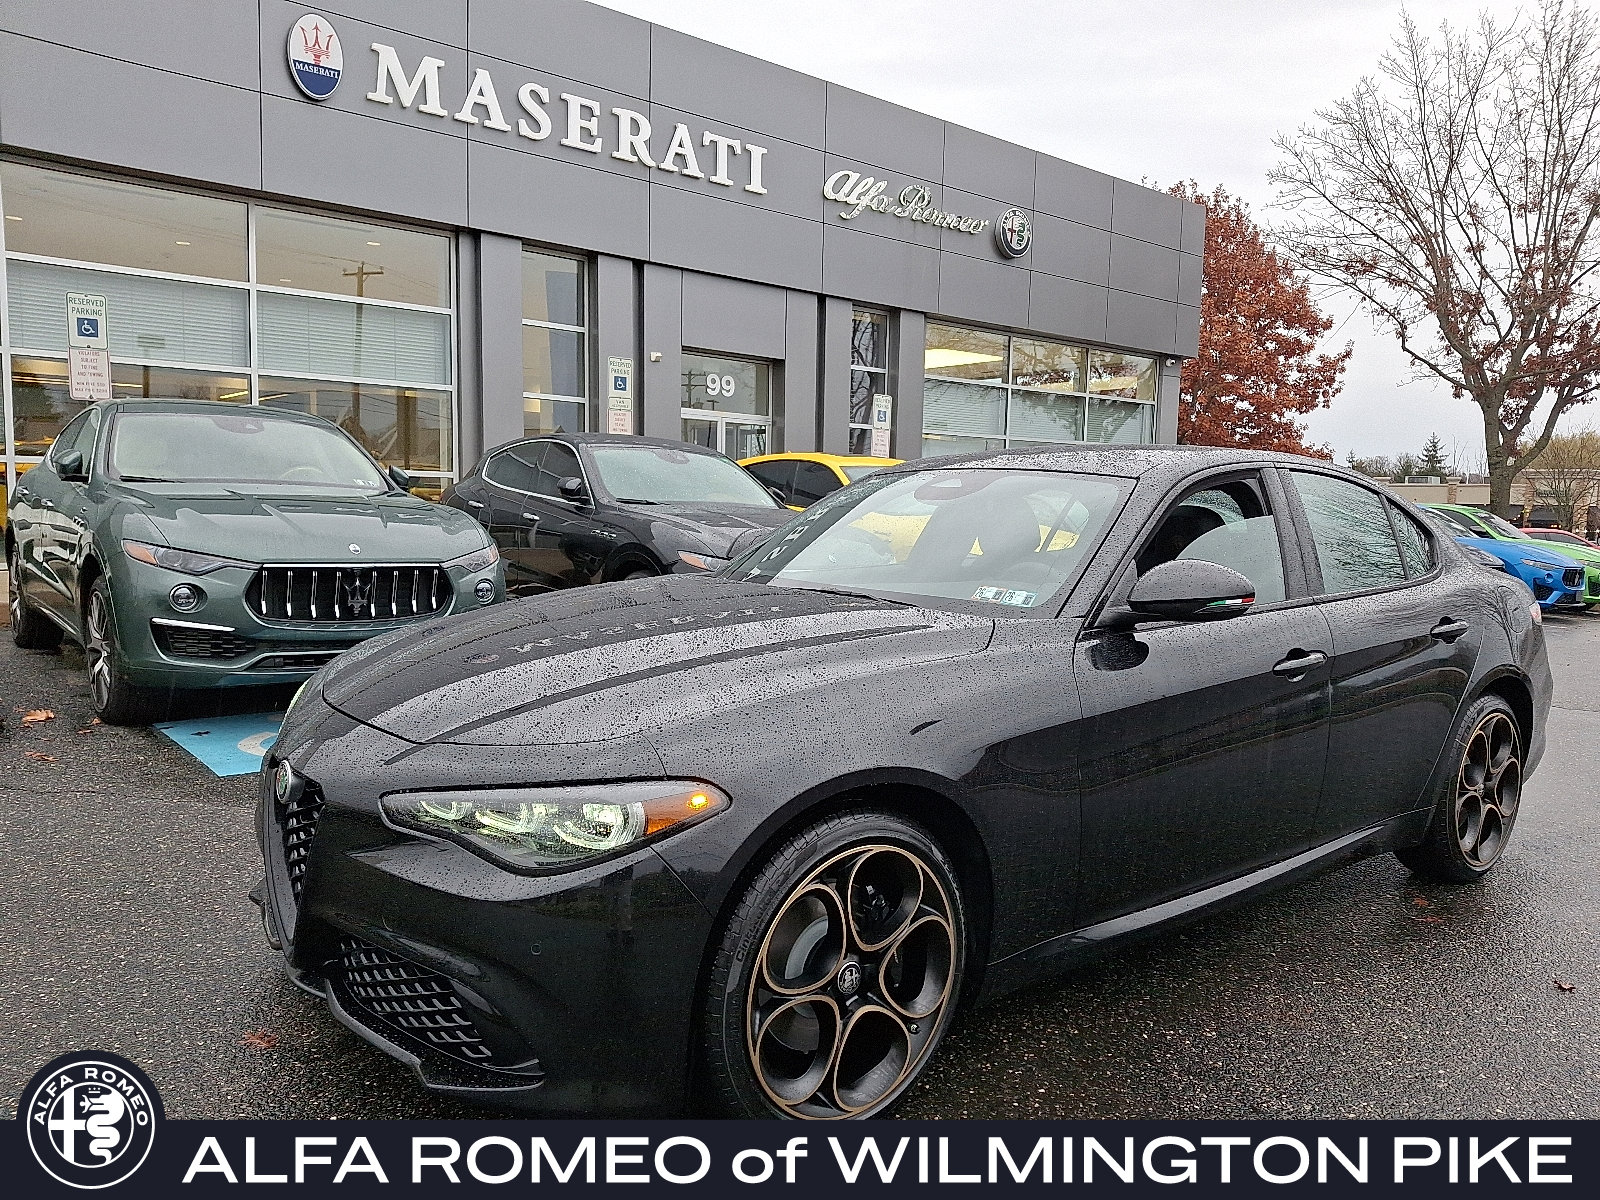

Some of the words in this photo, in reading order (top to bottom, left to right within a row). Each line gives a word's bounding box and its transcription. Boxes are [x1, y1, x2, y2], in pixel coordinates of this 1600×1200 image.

[296, 62, 339, 79] MASERATI
[366, 42, 769, 195] MASERATI
[68, 296, 104, 307] RESERVED
[71, 306, 103, 317] PARKING
[706, 373, 735, 397] 99
